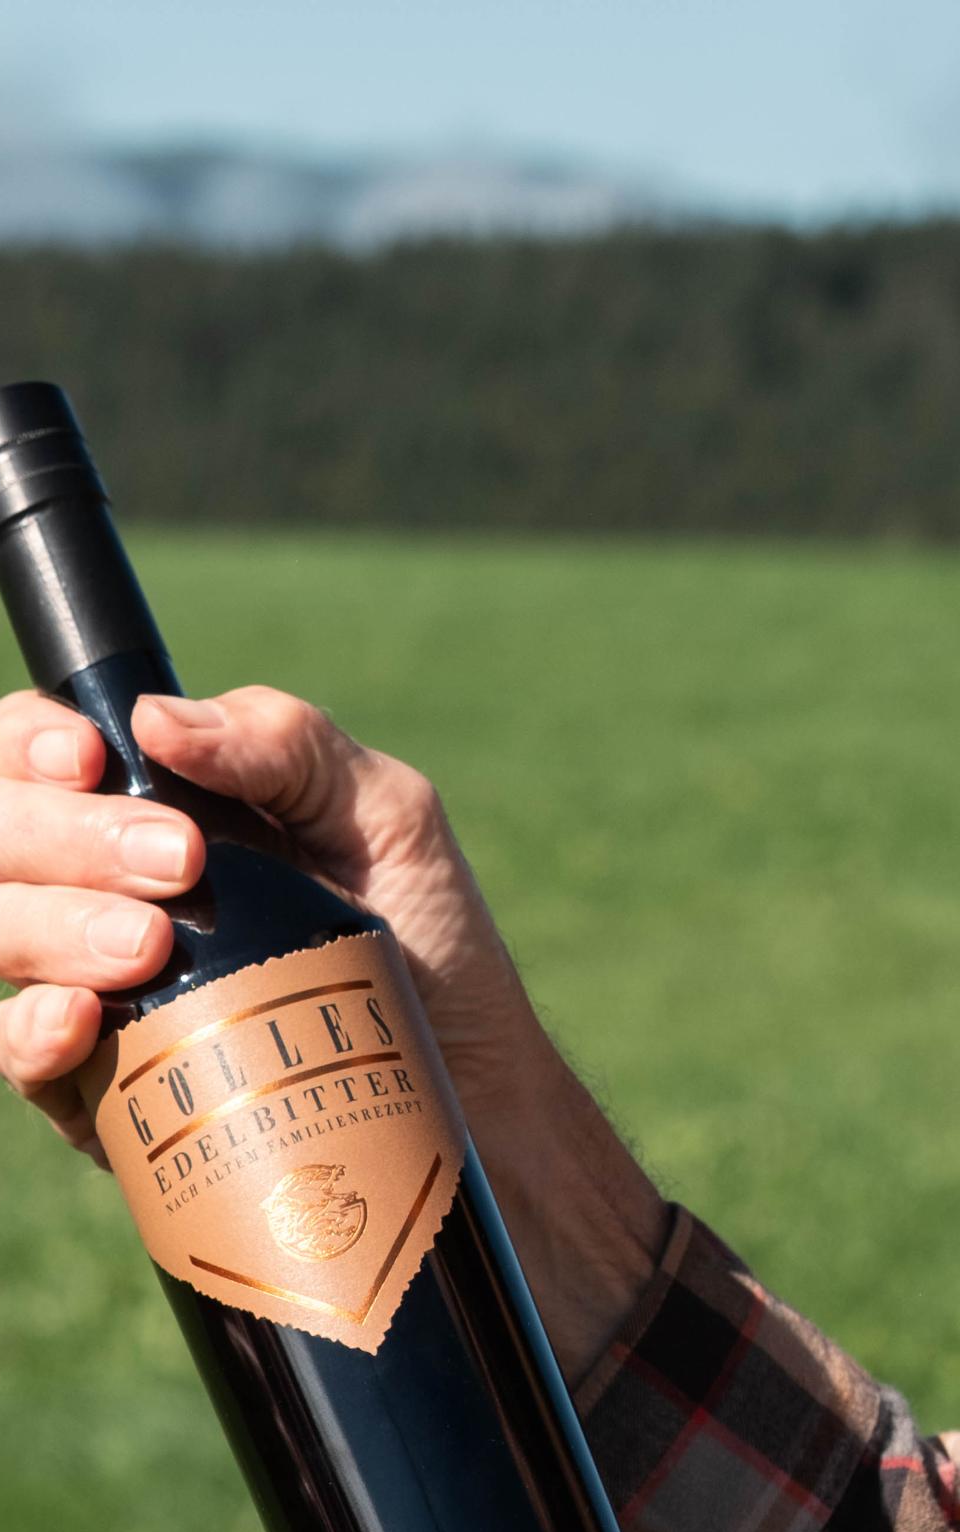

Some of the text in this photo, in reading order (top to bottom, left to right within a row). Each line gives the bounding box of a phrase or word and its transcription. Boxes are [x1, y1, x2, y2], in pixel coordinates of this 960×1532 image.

[126, 997, 394, 1147] GÖLLES
[152, 1067, 416, 1196] EDELBITTER
[165, 1099, 424, 1216] NACH ALTEM FAMILIENREZEPT
